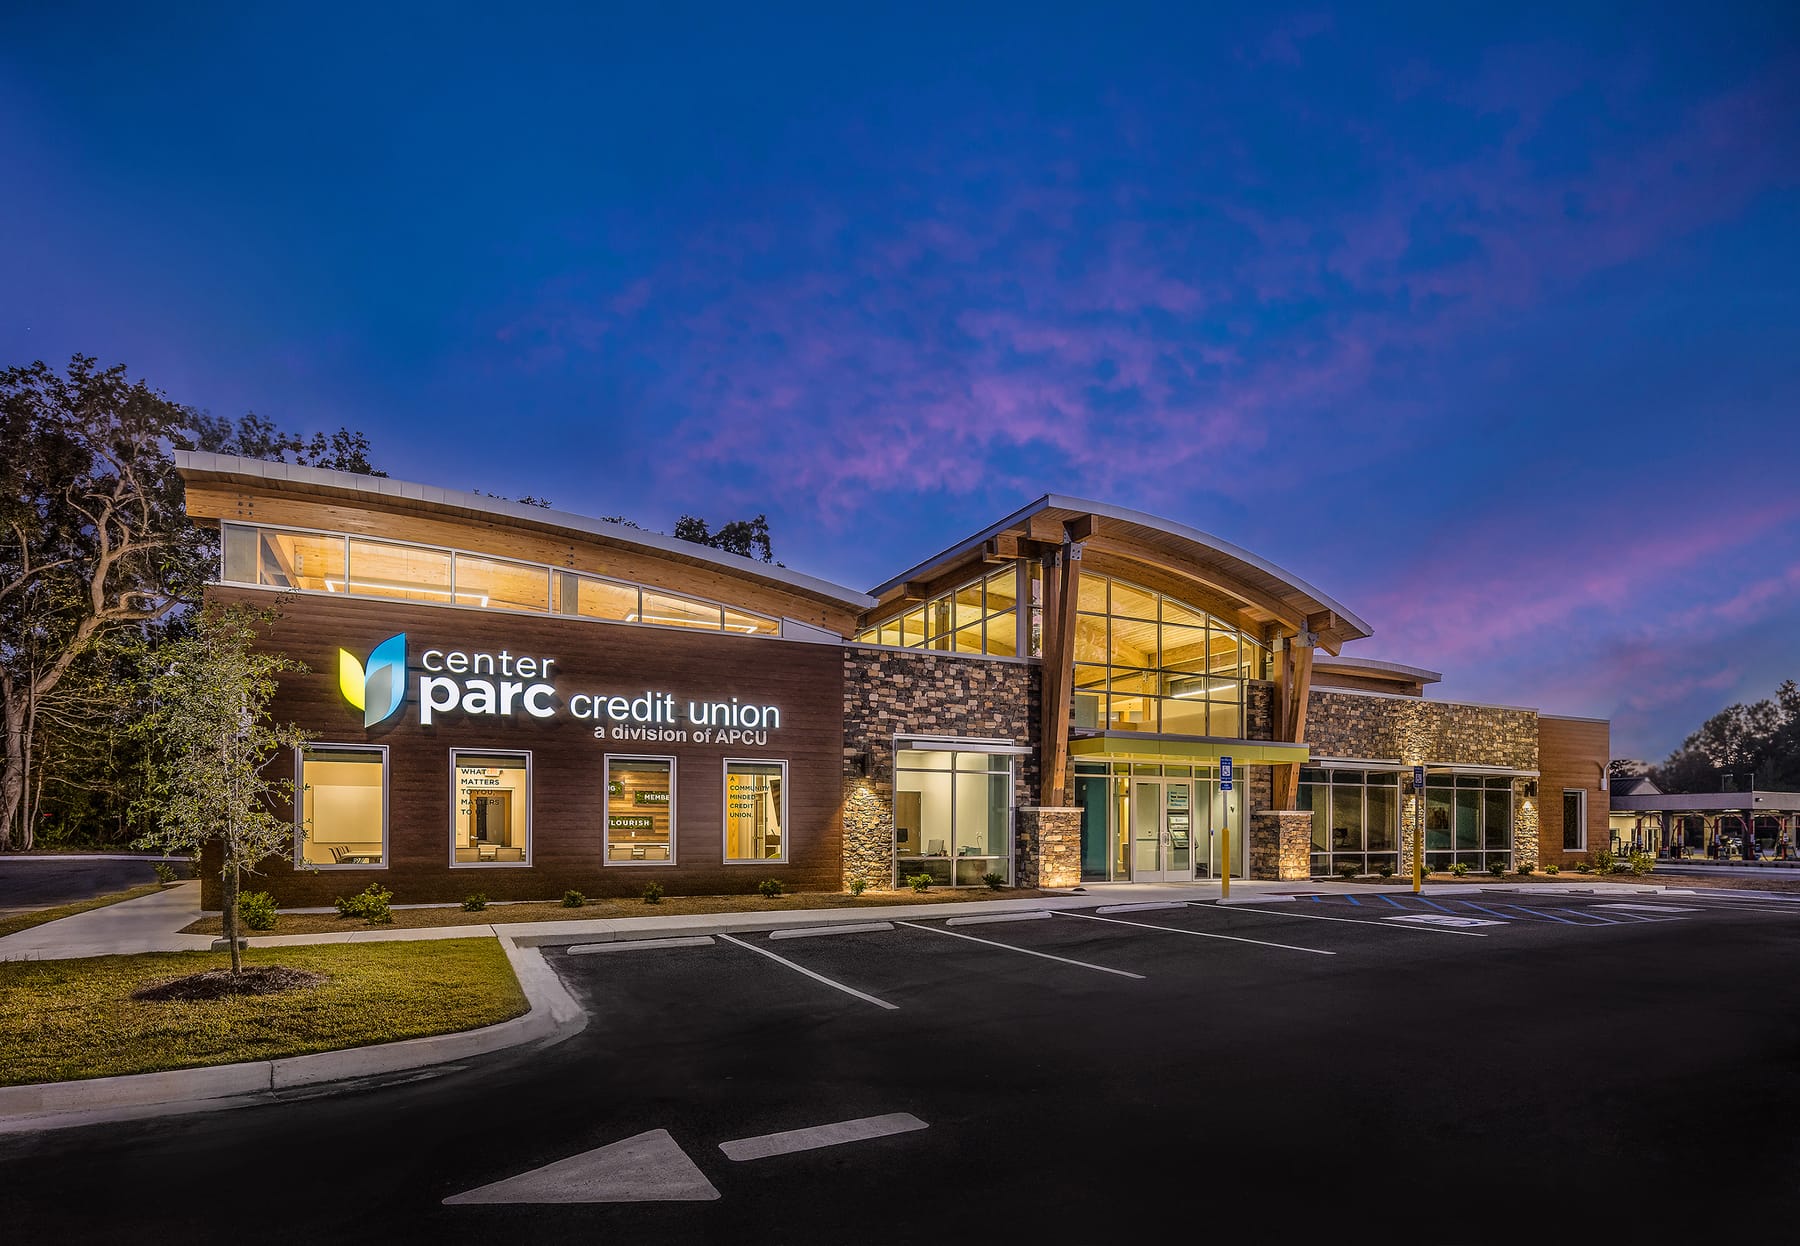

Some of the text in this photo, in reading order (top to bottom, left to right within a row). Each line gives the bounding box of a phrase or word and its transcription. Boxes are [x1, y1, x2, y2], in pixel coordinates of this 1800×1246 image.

[422, 650, 555, 678] center
[420, 676, 556, 725] parc
[570, 692, 780, 728] credit union
[594, 724, 768, 746] a division of APCU
